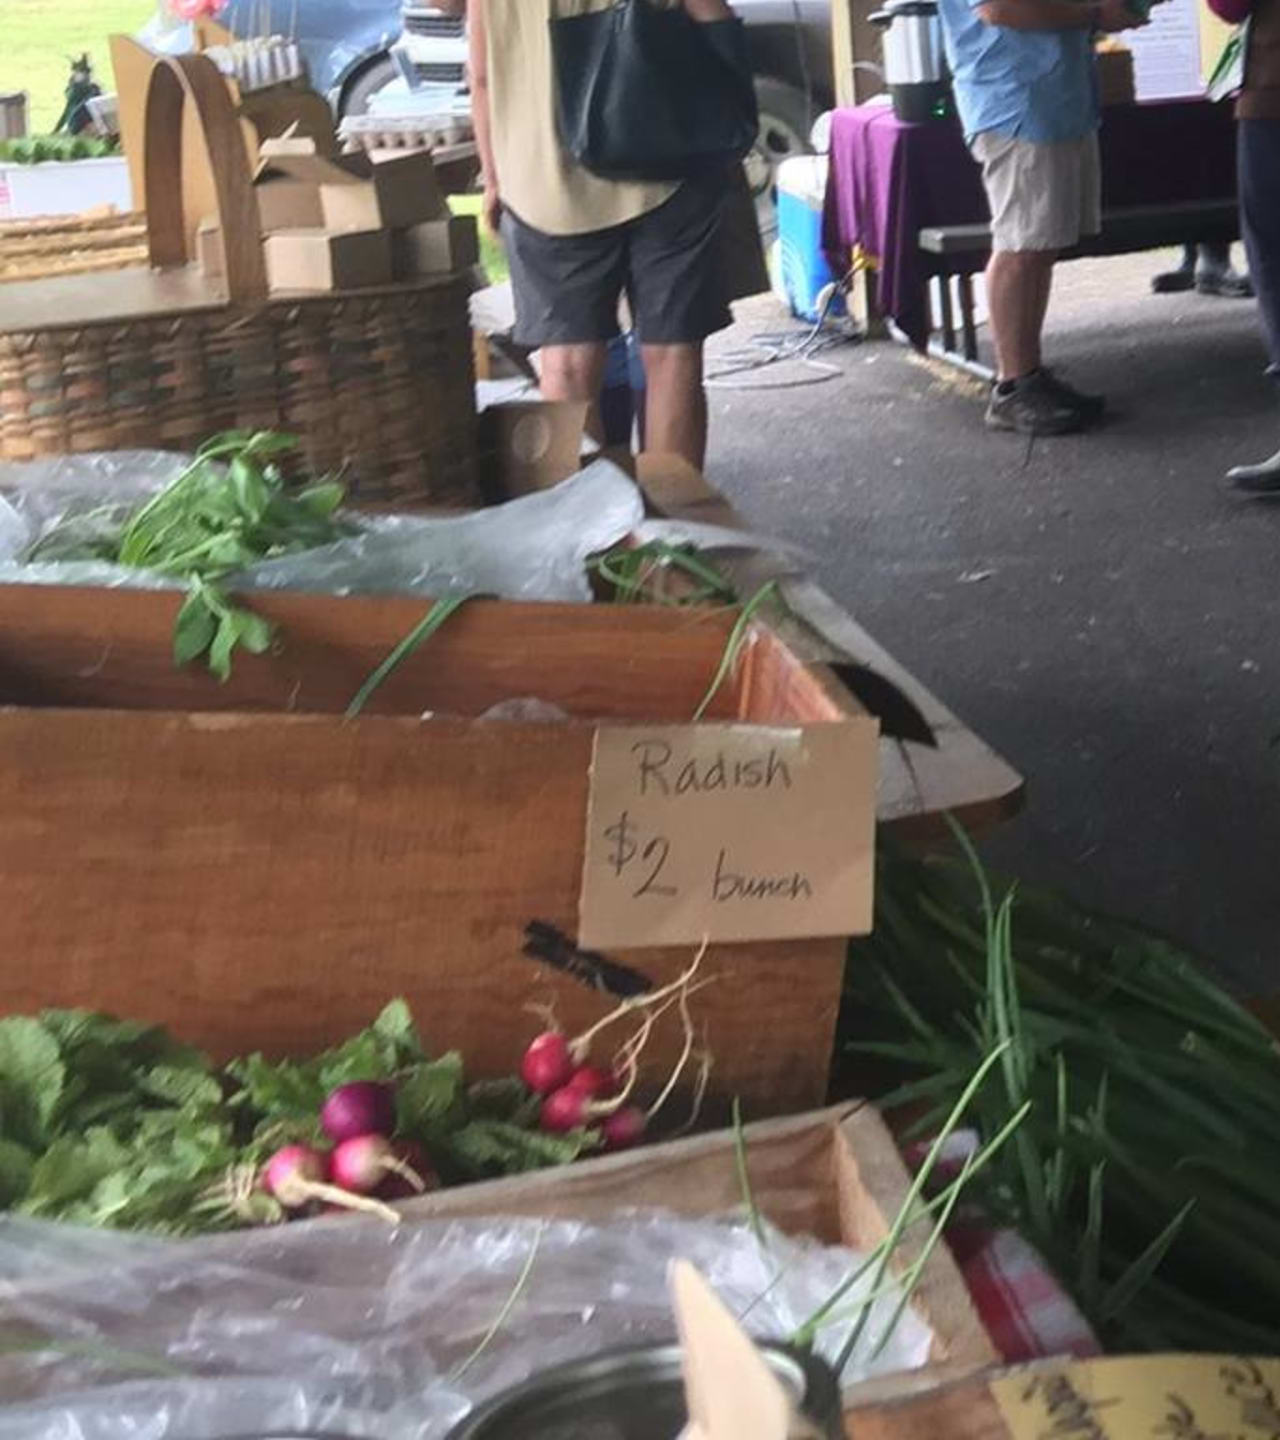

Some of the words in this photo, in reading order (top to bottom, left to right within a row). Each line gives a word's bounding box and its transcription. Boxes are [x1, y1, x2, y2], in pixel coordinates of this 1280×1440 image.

[632, 740, 793, 796] Radish
[604, 810, 678, 898] $2
[712, 848, 813, 902] bunch
